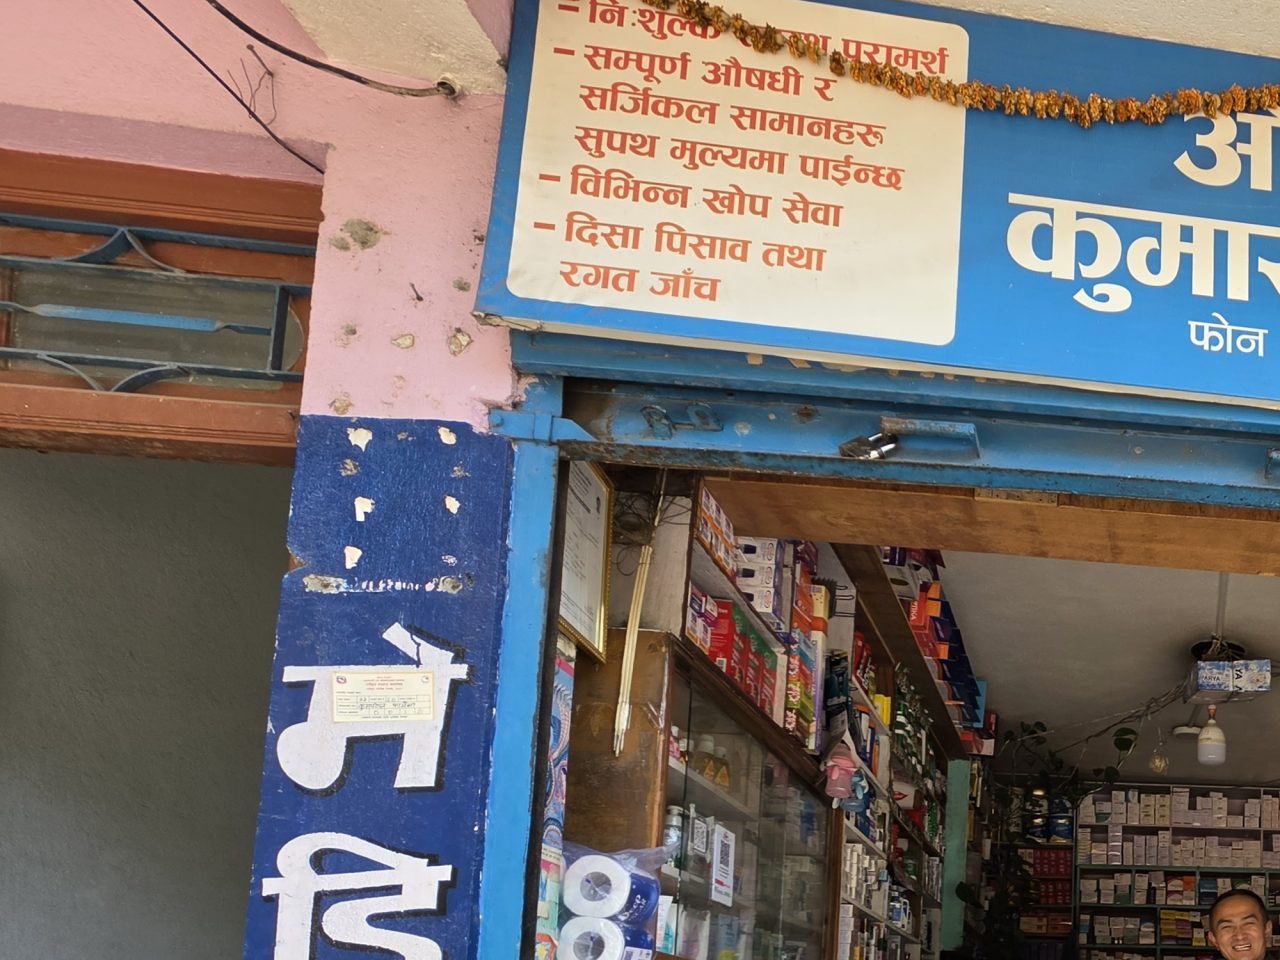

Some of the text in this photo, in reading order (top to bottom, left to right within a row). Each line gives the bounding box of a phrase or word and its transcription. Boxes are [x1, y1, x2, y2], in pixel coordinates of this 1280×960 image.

[584, 44, 838, 102] सम्पूर्ण औषधी र
[579, 82, 720, 125] सर्जिकल
[574, 125, 660, 159] सुपथ
[670, 137, 788, 175] मुल्यमा
[570, 164, 843, 227] विभिन्न खोप सेवा
[564, 211, 644, 249] दिसा
[761, 241, 827, 272] तथा
[560, 261, 721, 301] रगत जाँच
[1188, 312, 1268, 357] फोन
